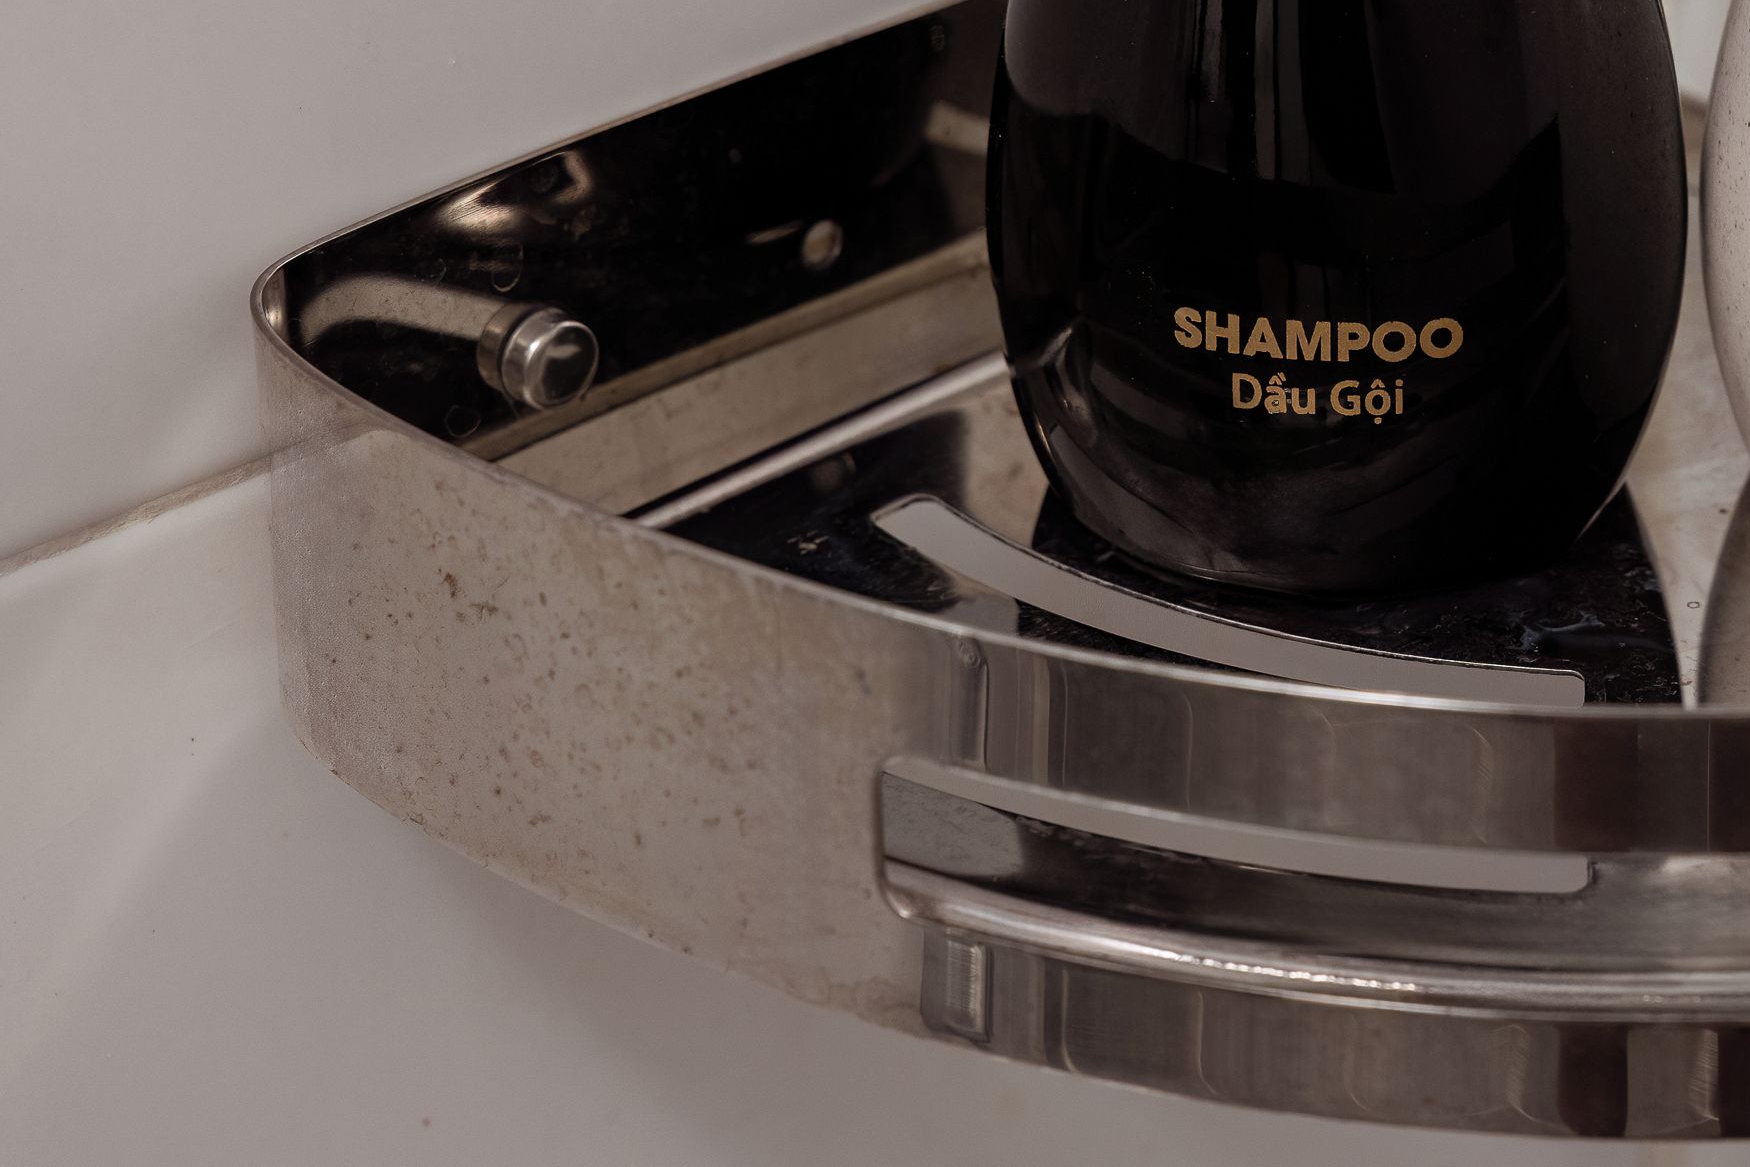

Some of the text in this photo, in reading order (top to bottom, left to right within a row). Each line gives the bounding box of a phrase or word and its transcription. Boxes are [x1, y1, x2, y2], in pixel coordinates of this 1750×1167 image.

[1173, 306, 1464, 363] SHAMPOO
[1231, 372, 1404, 425] Dầu Gội
